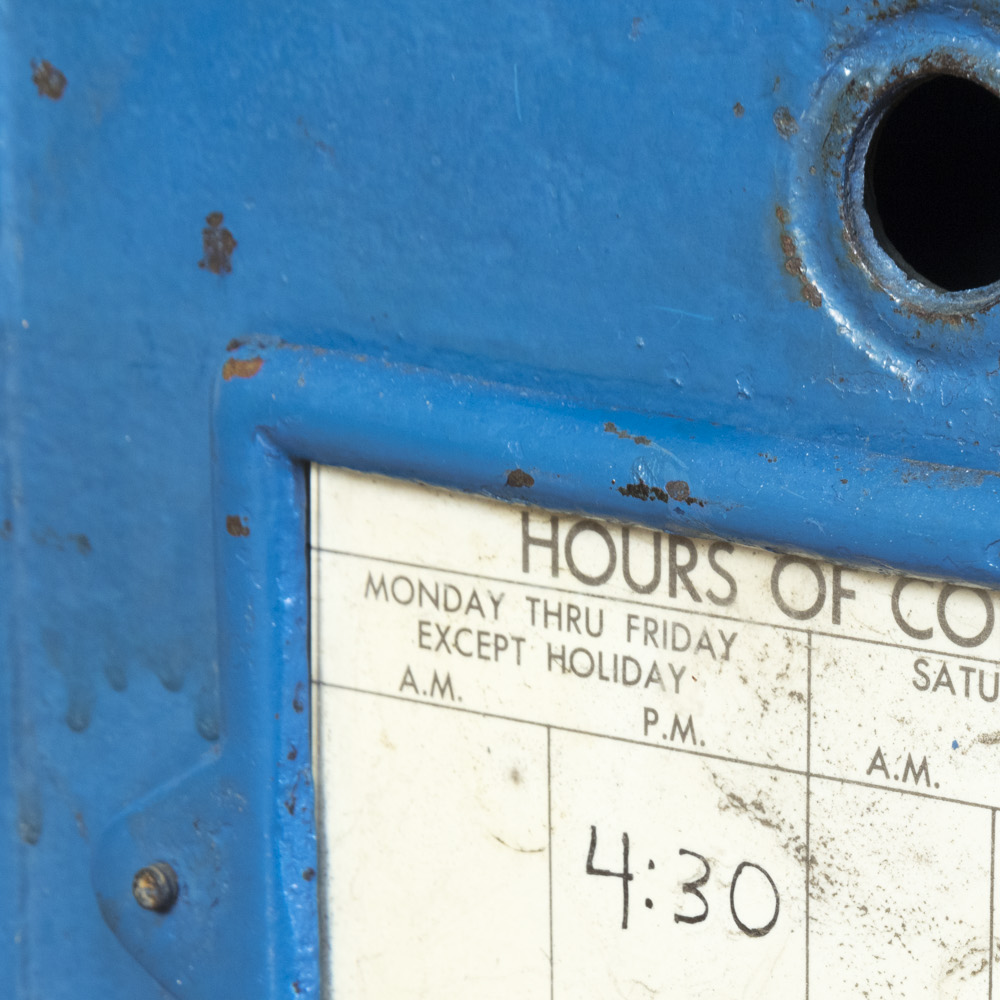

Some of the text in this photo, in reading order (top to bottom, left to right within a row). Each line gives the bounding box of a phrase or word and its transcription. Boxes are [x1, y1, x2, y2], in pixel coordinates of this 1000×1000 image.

[521, 511, 738, 606] HOURS
[770, 555, 856, 624] OF
[364, 571, 738, 661] MONDAY THRU FRIDAY
[399, 665, 464, 702] A.M.
[417, 620, 688, 694] EXCEPT HOLIDAY
[643, 706, 706, 747] P.M.
[866, 746, 941, 790] A.M.
[586, 825, 779, 938] 4:30
